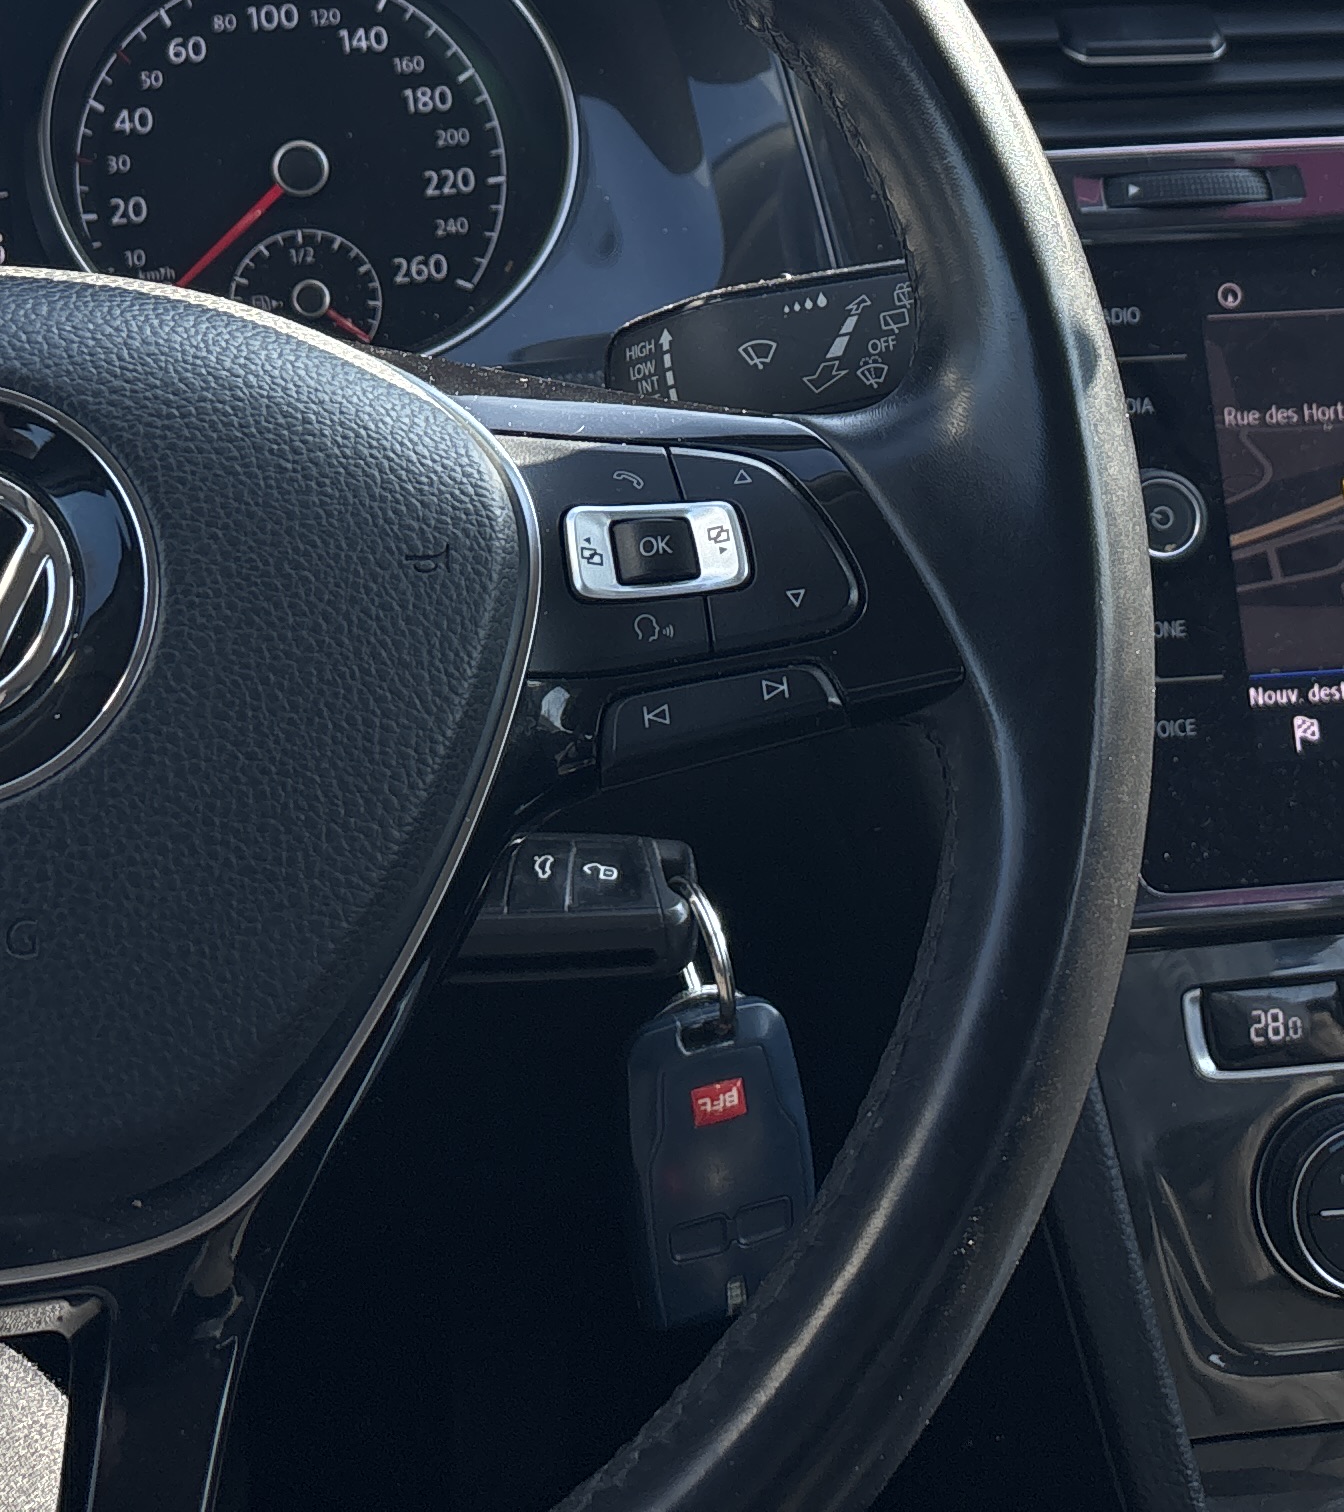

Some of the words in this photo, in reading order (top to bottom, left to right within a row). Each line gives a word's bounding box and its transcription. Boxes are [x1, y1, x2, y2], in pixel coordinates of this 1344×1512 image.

[212, 13, 237, 33] 80
[246, 3, 299, 31] 100
[310, 7, 341, 27] 120
[168, 35, 207, 64] 60
[338, 25, 389, 54] 140
[392, 54, 425, 75] 160
[139, 69, 163, 90] 50
[402, 85, 453, 114] 180
[113, 106, 153, 136] 40
[435, 127, 470, 147] 200
[106, 155, 131, 174] 30
[423, 167, 476, 196] 220
[110, 196, 148, 226] 20
[434, 216, 469, 237] 240
[124, 248, 146, 268] 10
[289, 246, 316, 266] 1/2
[392, 253, 448, 285] 260
[1103, 306, 1141, 326] DIO
[625, 338, 656, 362] HIGH
[868, 336, 897, 356] OFF
[629, 358, 656, 381] LOW
[637, 375, 659, 395] INT
[1126, 396, 1155, 416] DIA
[1223, 405, 1261, 429] Rue
[1265, 404, 1299, 427] des
[639, 534, 674, 557] OK
[1248, 686, 1305, 707] Nouv.
[1155, 718, 1198, 738] OICE
[1249, 1007, 1303, 1046] 28.0
